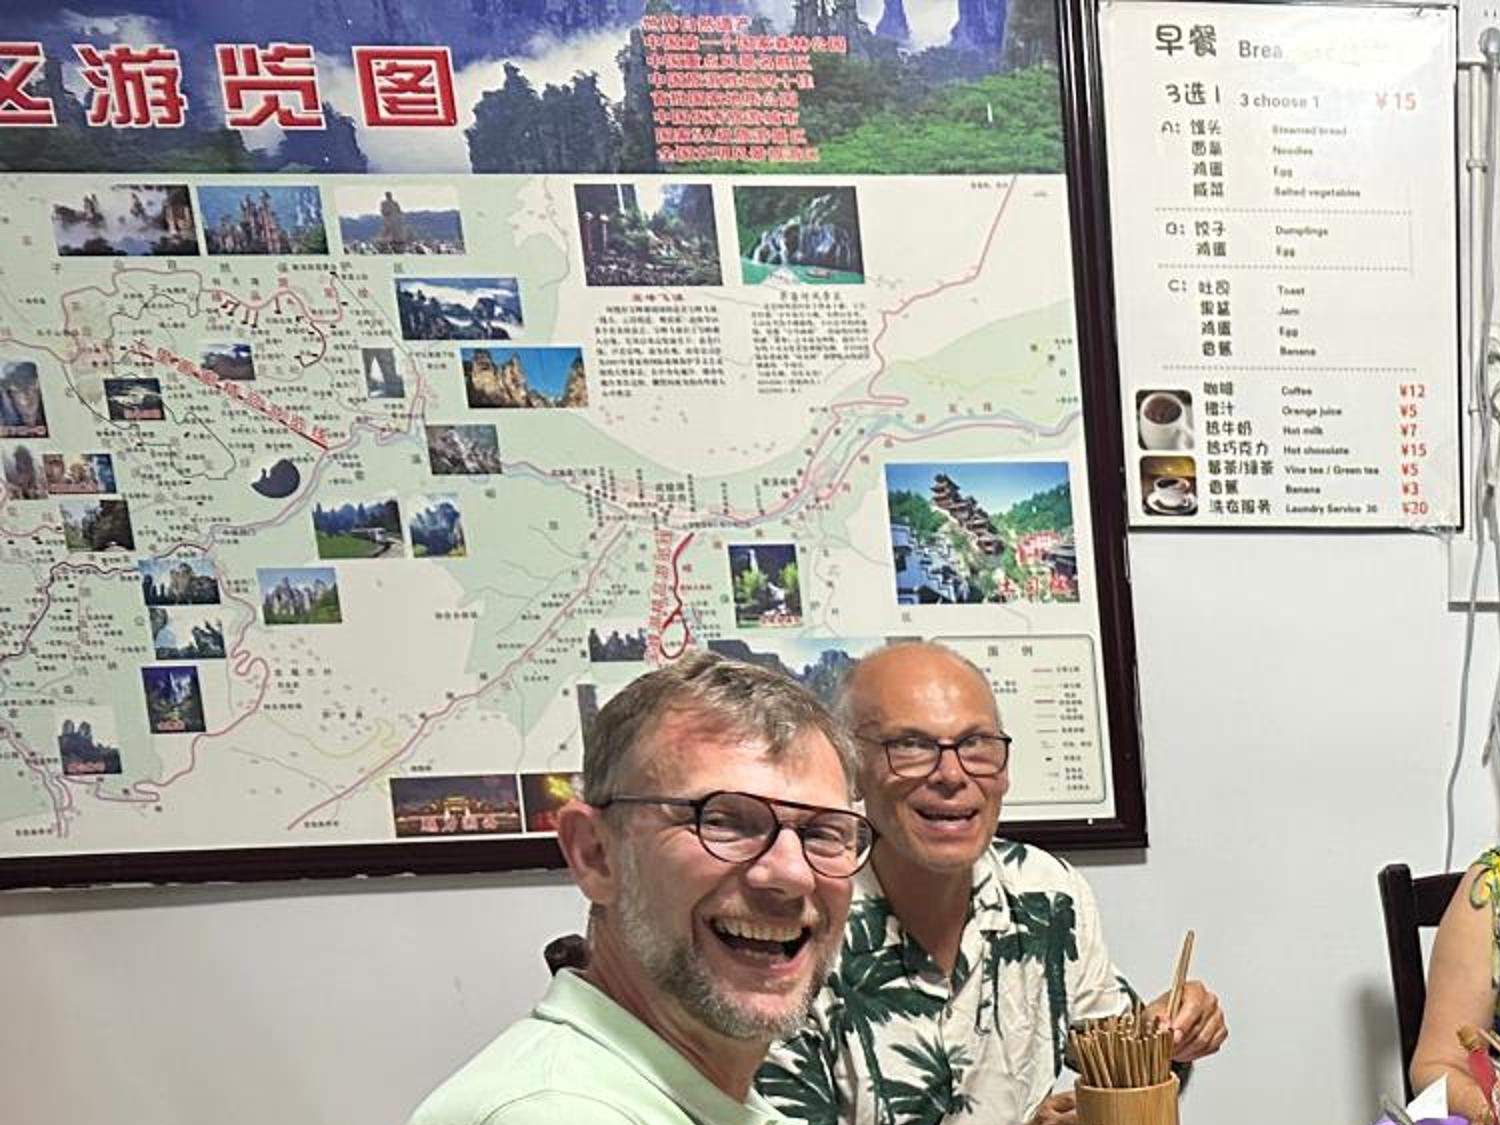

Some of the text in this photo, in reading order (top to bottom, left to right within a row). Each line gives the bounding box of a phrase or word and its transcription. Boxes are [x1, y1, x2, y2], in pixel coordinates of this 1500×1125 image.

[1156, 25, 1217, 57] 早餐
[1240, 94, 1249, 107] 3
[1253, 95, 1307, 108] choose
[1277, 286, 1305, 296] Toast
[1279, 346, 1317, 357] Banana
[1400, 384, 1425, 399] ¥12
[1400, 404, 1418, 418] ¥5
[1400, 424, 1417, 437] ¥7
[1401, 443, 1427, 458] ¥15
[1401, 464, 1418, 477] ¥5
[1285, 486, 1320, 496] Banana
[1402, 483, 1419, 497] ¥3
[1402, 502, 1428, 516] ¥30
